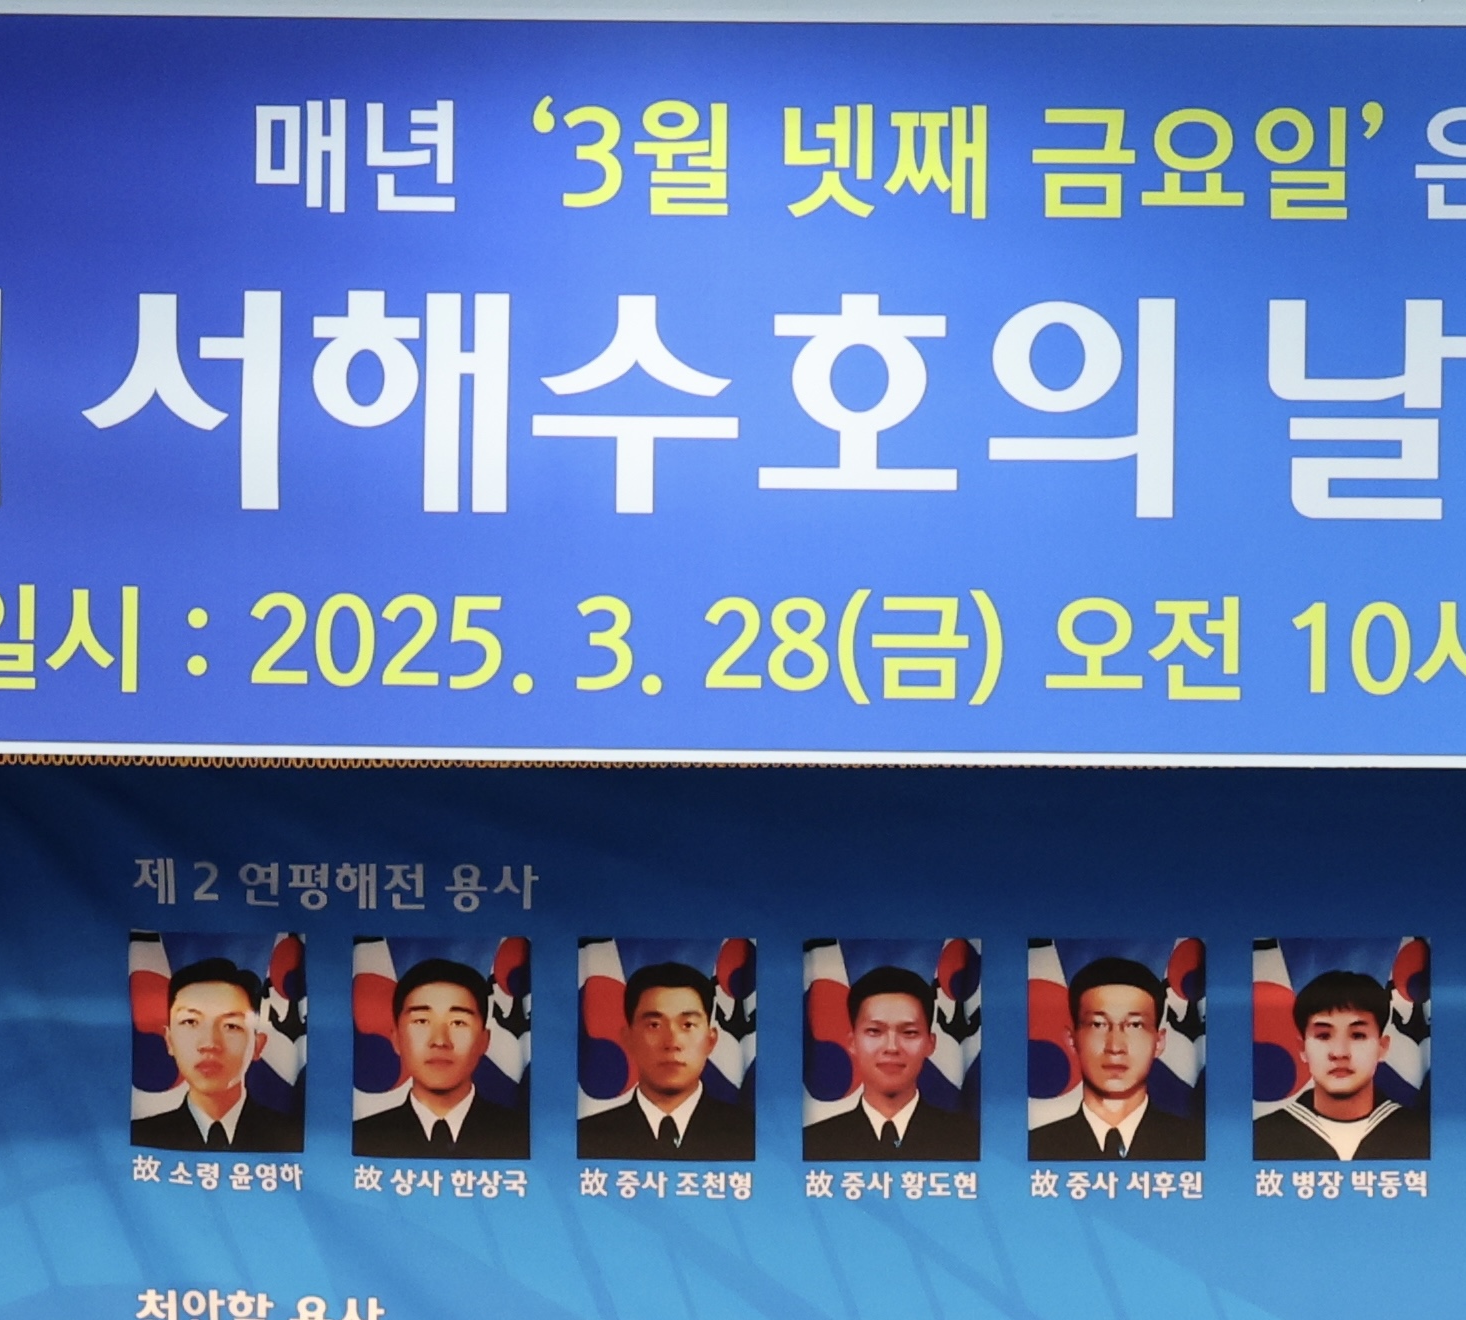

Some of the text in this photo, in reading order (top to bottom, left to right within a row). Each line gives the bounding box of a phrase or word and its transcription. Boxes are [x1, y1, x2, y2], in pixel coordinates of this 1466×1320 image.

[256, 99, 455, 213] 매년
[533, 96, 728, 216] ‘3월
[784, 104, 987, 219] 넷째
[82, 290, 1175, 518] 서해수호의
[187, 608, 208, 676] :
[250, 592, 533, 694] 2025.
[576, 595, 662, 696] 3.
[704, 589, 1003, 705] 28(금)
[1045, 596, 1241, 701] 오전
[133, 857, 539, 913] 제 2 연평해전 용사
[133, 1155, 303, 1192] 故 소령 윤영하
[354, 1164, 528, 1198] 故 상사 한상국
[580, 1168, 752, 1200] 故 중사 조천형
[1030, 1169, 1203, 1200] 故 중사 서후원
[1255, 1169, 1427, 1199] 故 병장 박동혁
